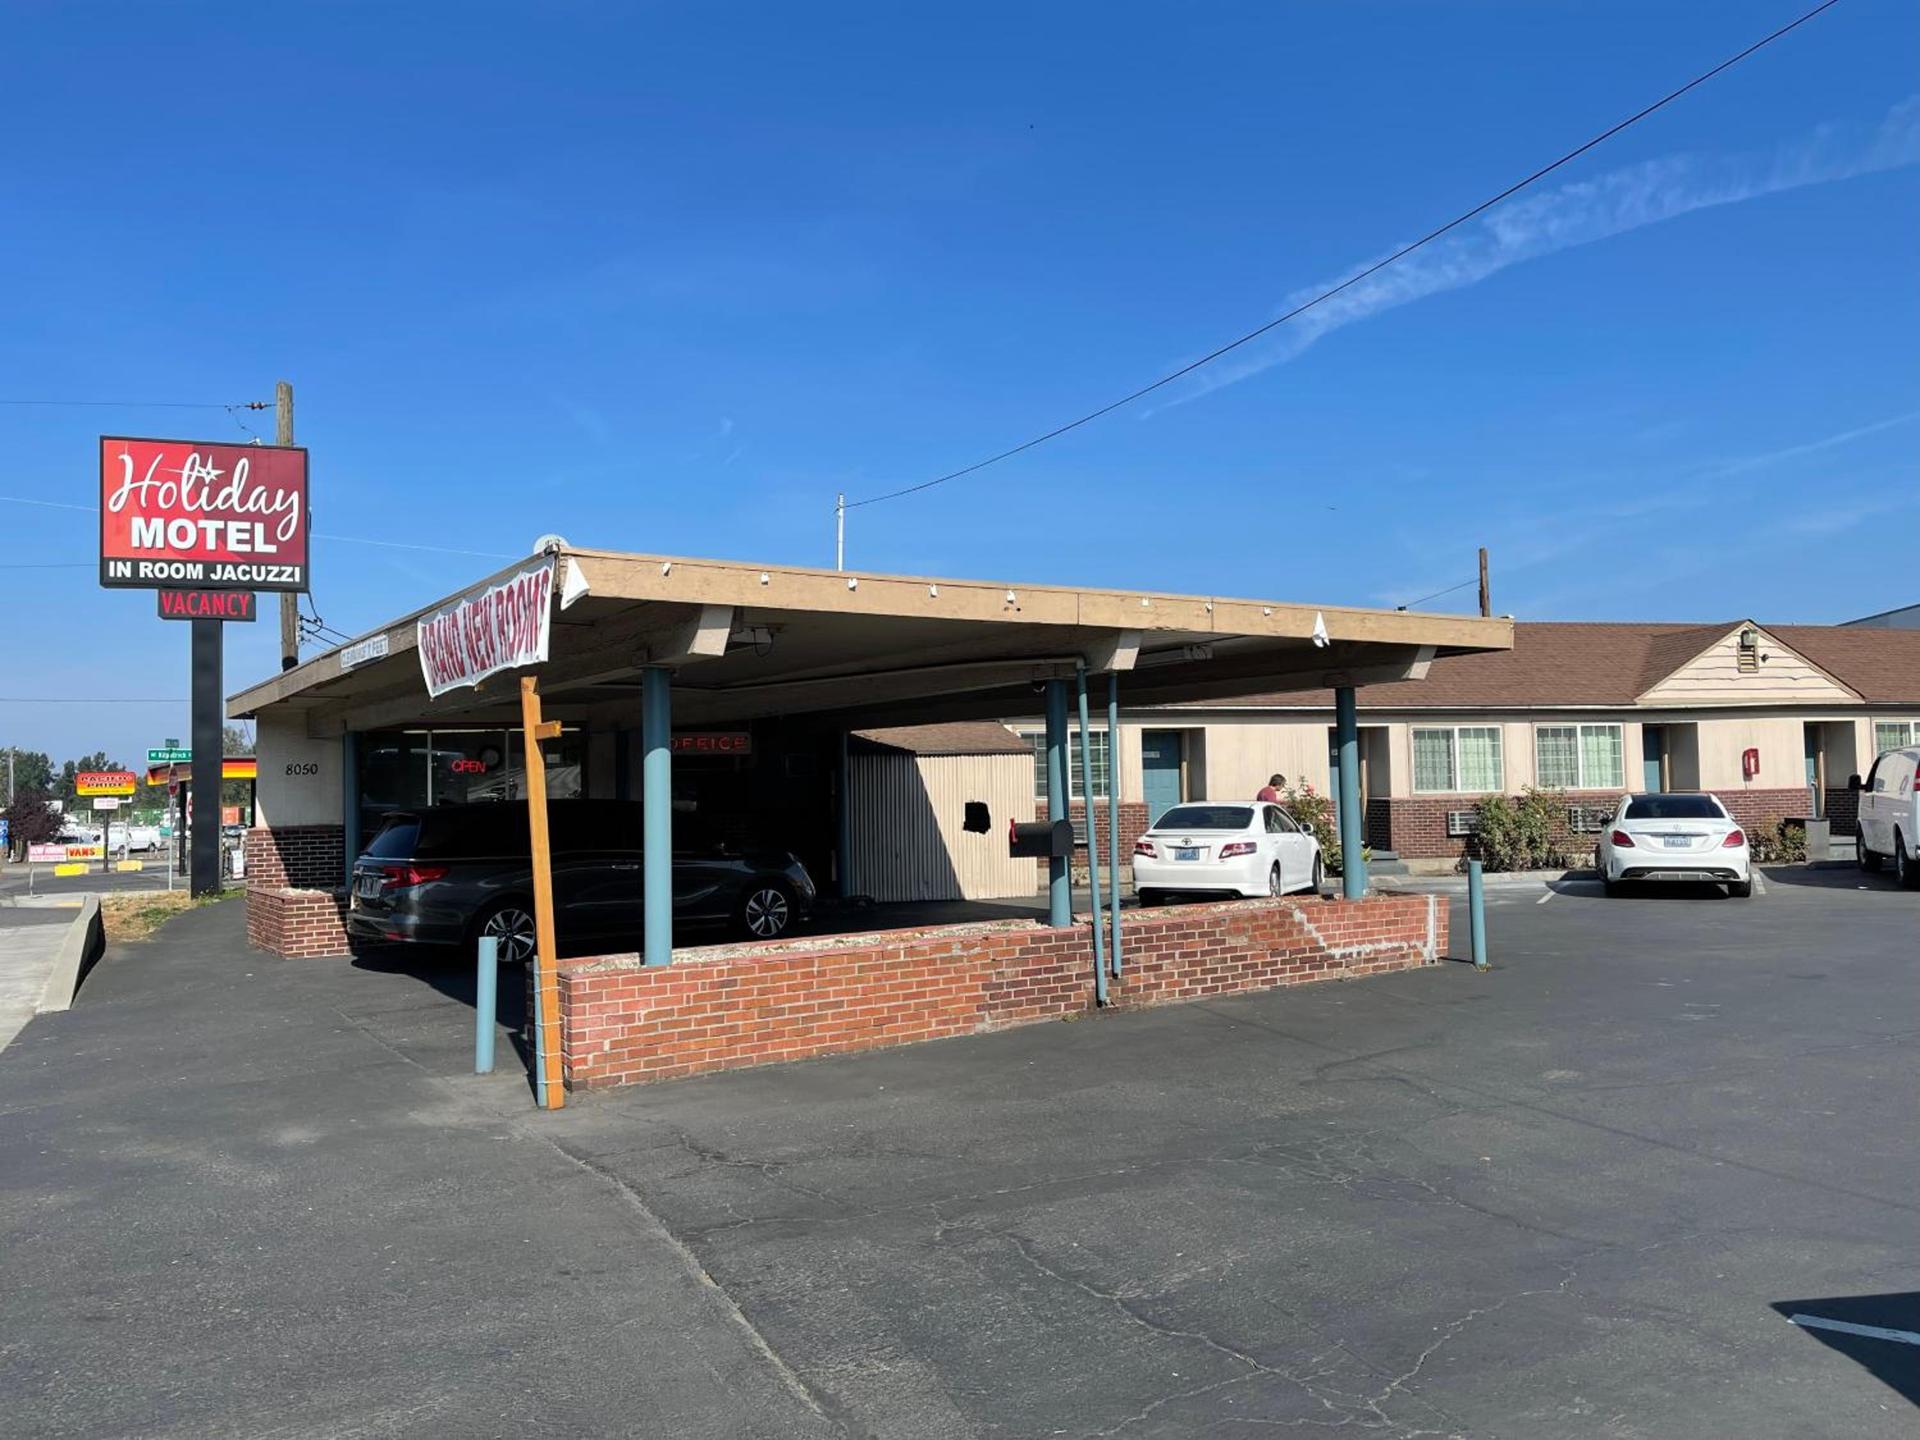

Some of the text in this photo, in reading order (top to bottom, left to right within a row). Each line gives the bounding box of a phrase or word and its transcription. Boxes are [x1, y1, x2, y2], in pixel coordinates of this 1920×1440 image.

[108, 452, 299, 542] Holiday
[130, 516, 277, 553] MOTEL
[108, 561, 300, 583] IN ROOM JACUZZI
[161, 591, 250, 616] VACANCY
[421, 568, 550, 688] BRAND NEW ROOMS
[286, 763, 319, 776] 8050
[451, 759, 486, 773] OPEN
[68, 847, 96, 857] VANS
